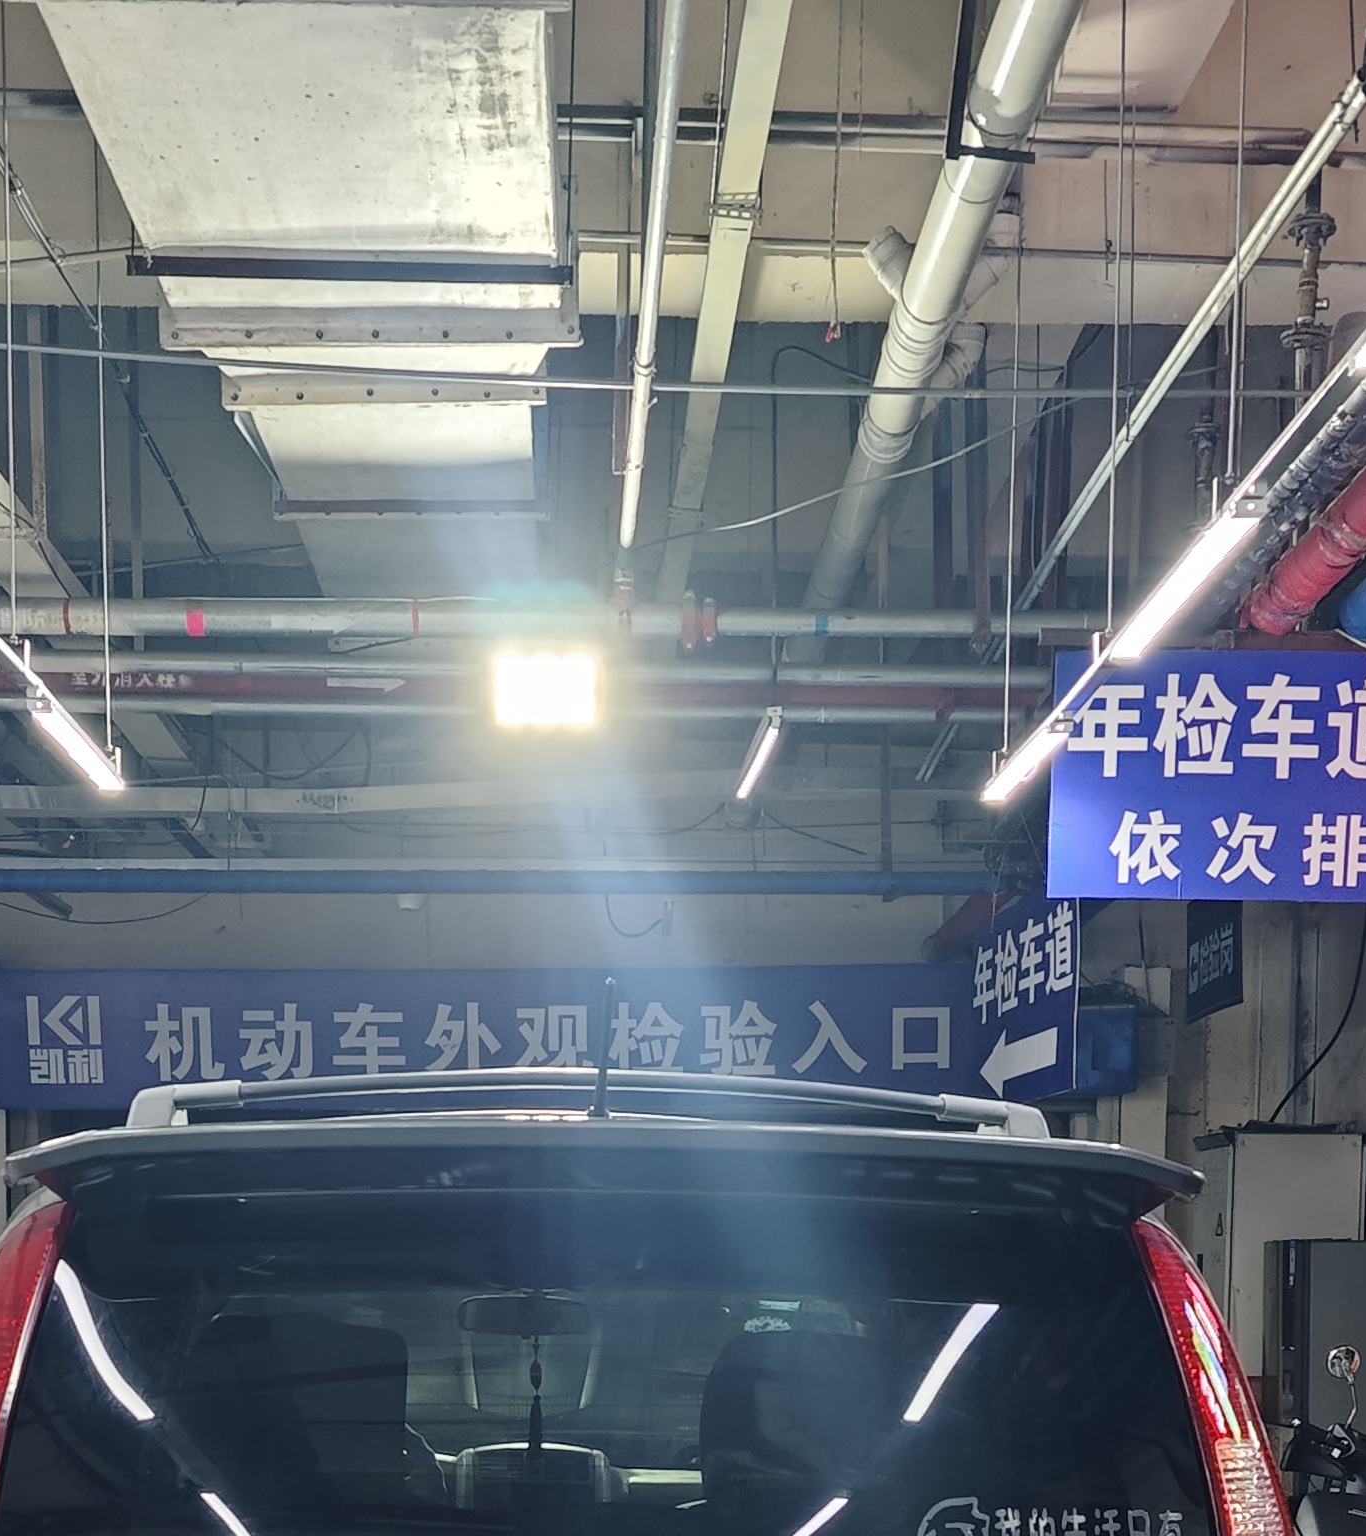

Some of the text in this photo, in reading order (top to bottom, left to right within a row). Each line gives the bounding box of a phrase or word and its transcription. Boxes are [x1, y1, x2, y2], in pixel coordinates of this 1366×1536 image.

[972, 900, 1074, 1025] 年检车道
[29, 1048, 104, 1085] 凯利
[144, 1000, 951, 1083] 机动车外观检验入口
